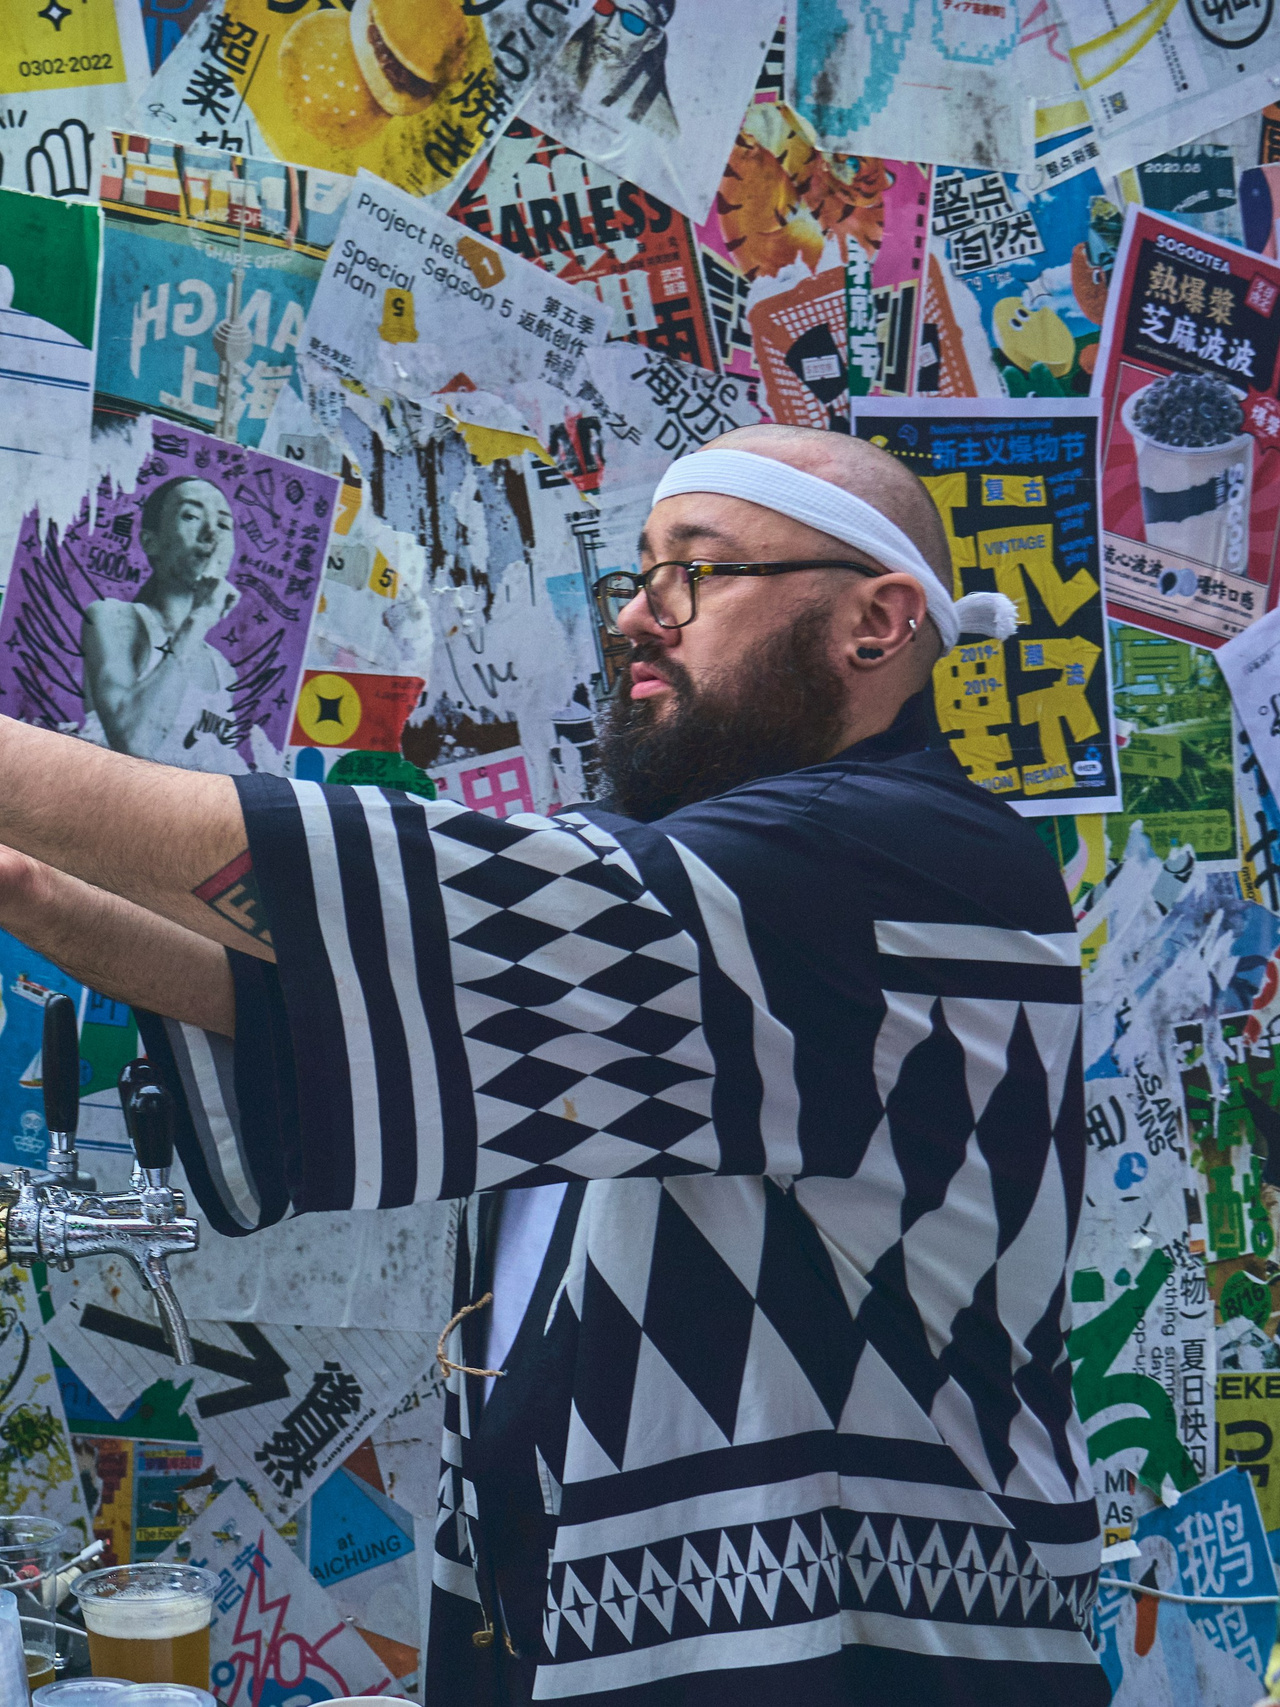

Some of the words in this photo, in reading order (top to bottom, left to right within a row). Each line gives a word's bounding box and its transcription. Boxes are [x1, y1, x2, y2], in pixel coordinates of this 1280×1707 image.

[357, 193, 426, 245] Project
[332, 260, 377, 300] Plan
[341, 239, 416, 292] Special
[421, 256, 495, 311] Season
[498, 298, 515, 318] 5
[541, 295, 597, 336] 第五季
[1139, 302, 1257, 378] 芝麻波波
[983, 535, 1047, 556] VINTAGE
[1023, 763, 1069, 786] REMIX
[1149, 1346, 1162, 1381] day
[337, 1533, 356, 1550] at
[1176, 1500, 1254, 1598] 鹅
